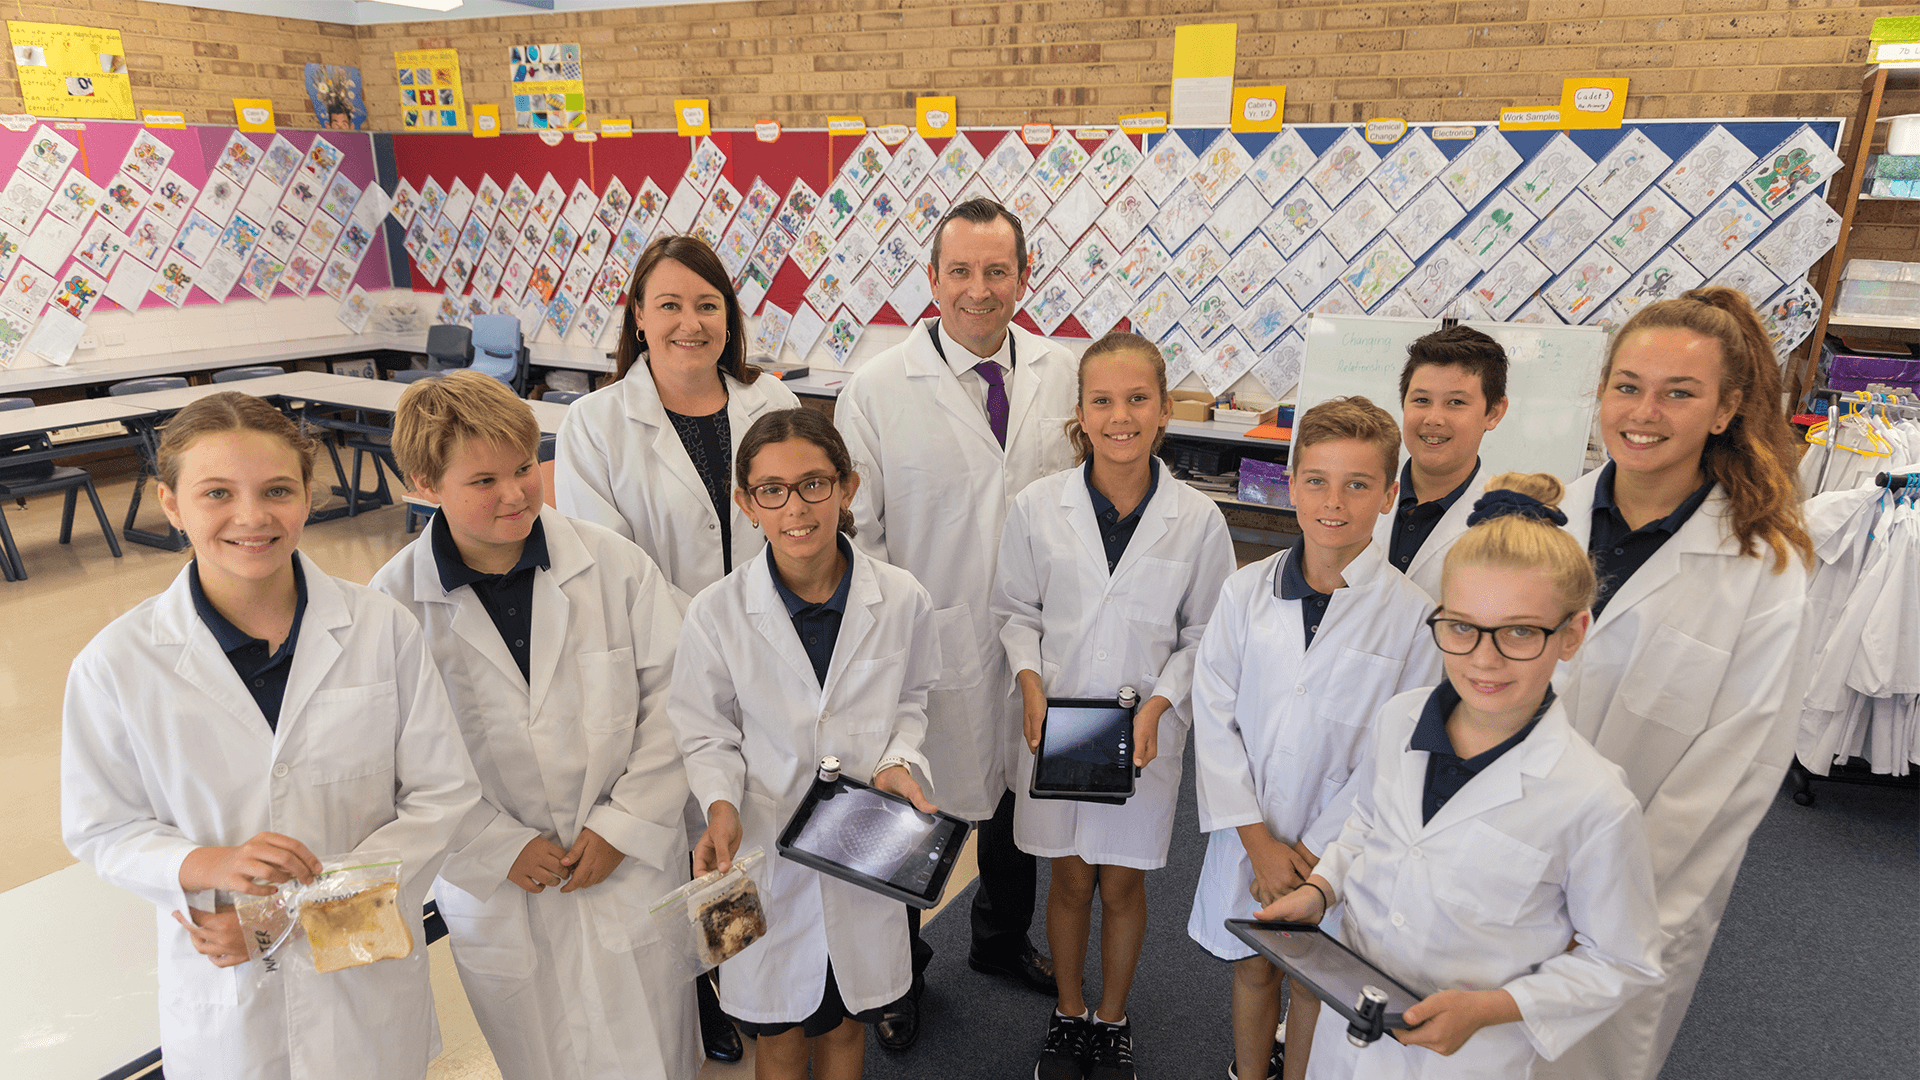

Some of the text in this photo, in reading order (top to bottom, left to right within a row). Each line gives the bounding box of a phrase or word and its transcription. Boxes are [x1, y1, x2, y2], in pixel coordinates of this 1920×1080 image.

[1576, 91, 1610, 100] Cadet 3
[1247, 101, 1267, 109] Cabin
[1503, 113, 1560, 122] Work Samples
[1139, 118, 1165, 127] Samples
[1368, 123, 1401, 131] Chemical
[890, 128, 907, 136] Taking
[1433, 129, 1474, 137] Electronics
[1027, 135, 1049, 143] Change
[1370, 133, 1398, 141] Change
[1341, 331, 1392, 353] Changing
[1336, 359, 1396, 376] Relationships
[255, 929, 278, 973] WATER
